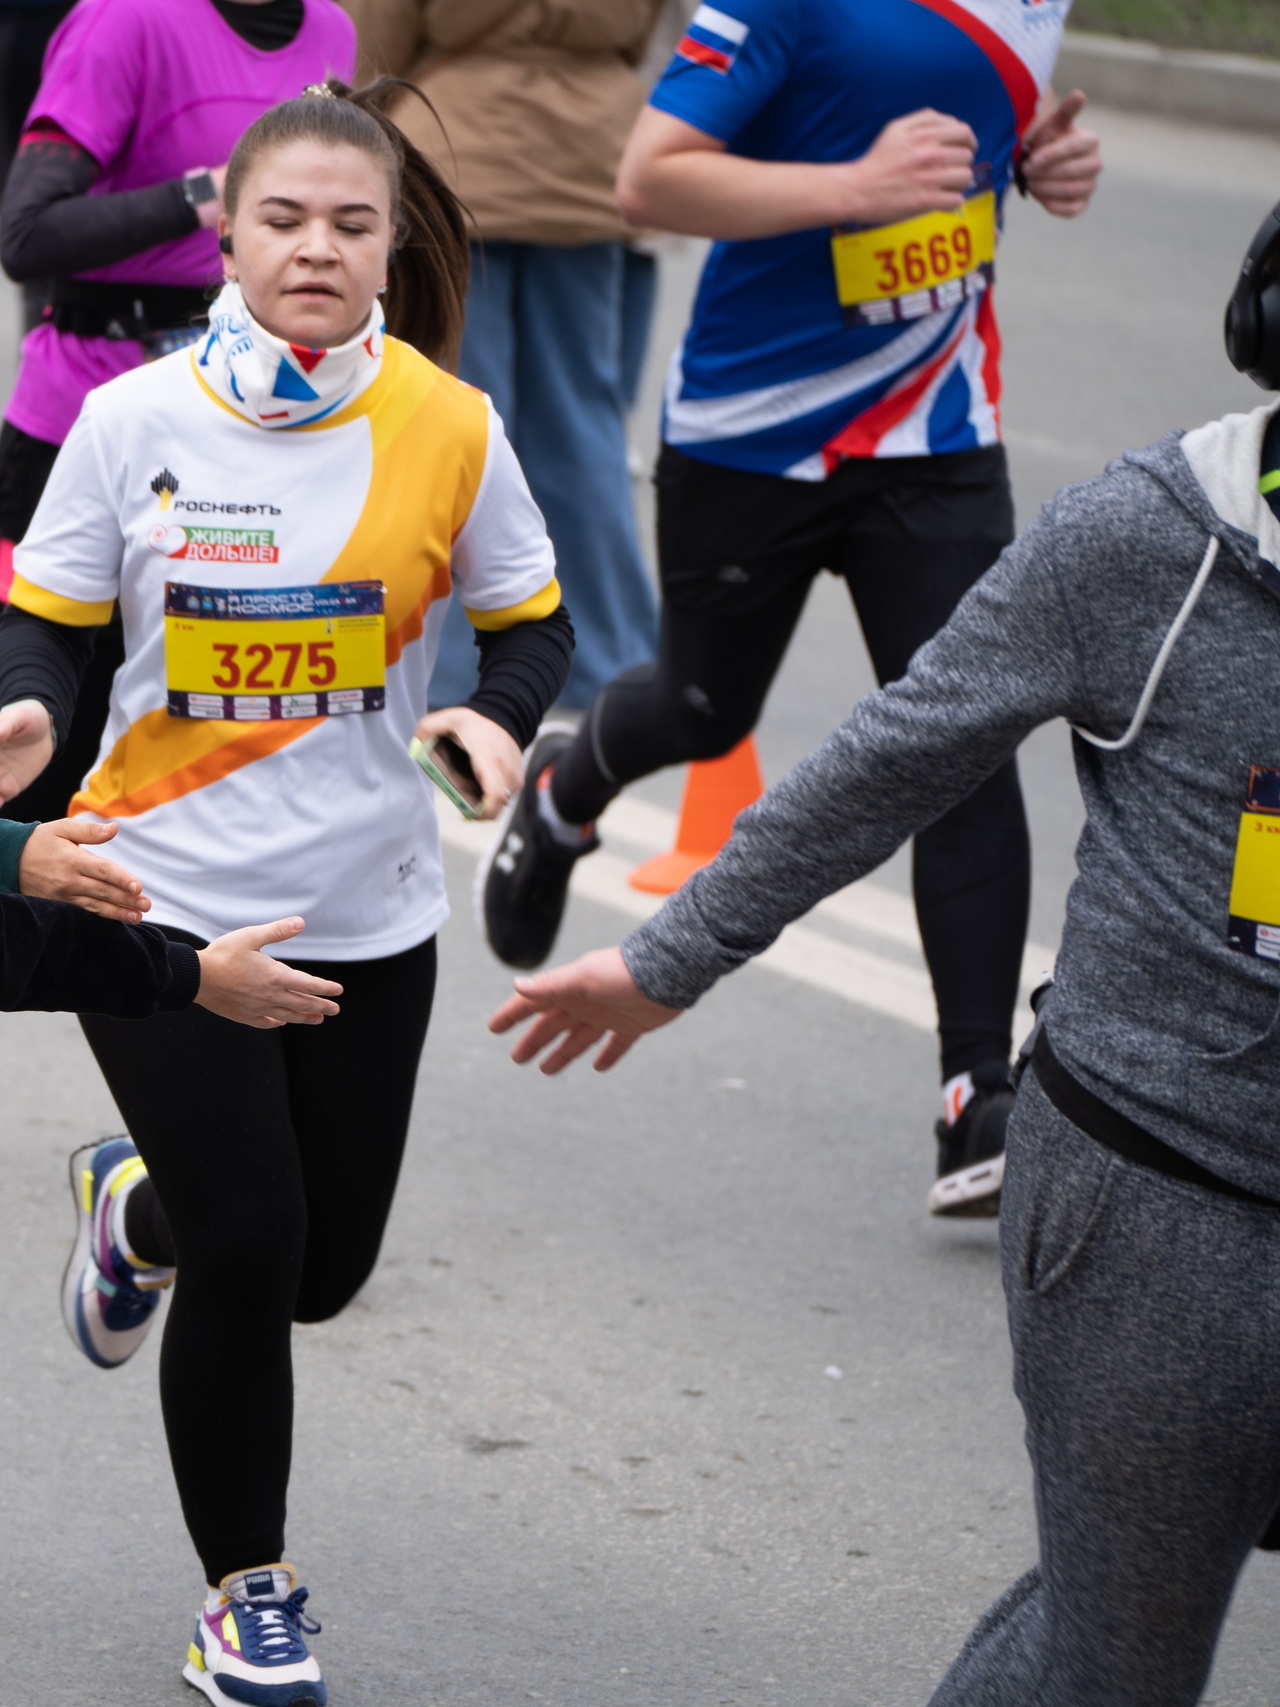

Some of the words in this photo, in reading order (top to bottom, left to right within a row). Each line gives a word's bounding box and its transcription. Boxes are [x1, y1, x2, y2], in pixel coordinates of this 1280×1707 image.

[873, 225, 973, 293] 3669
[174, 500, 282, 516] РОСНЕФТЬ
[190, 528, 271, 546] ЖИВИТЕ
[185, 543, 275, 563] ДОЛЬШЕ!
[228, 602, 315, 615] КОСМОС
[212, 641, 337, 690] 3275
[246, 1574, 270, 1584] PUMA
